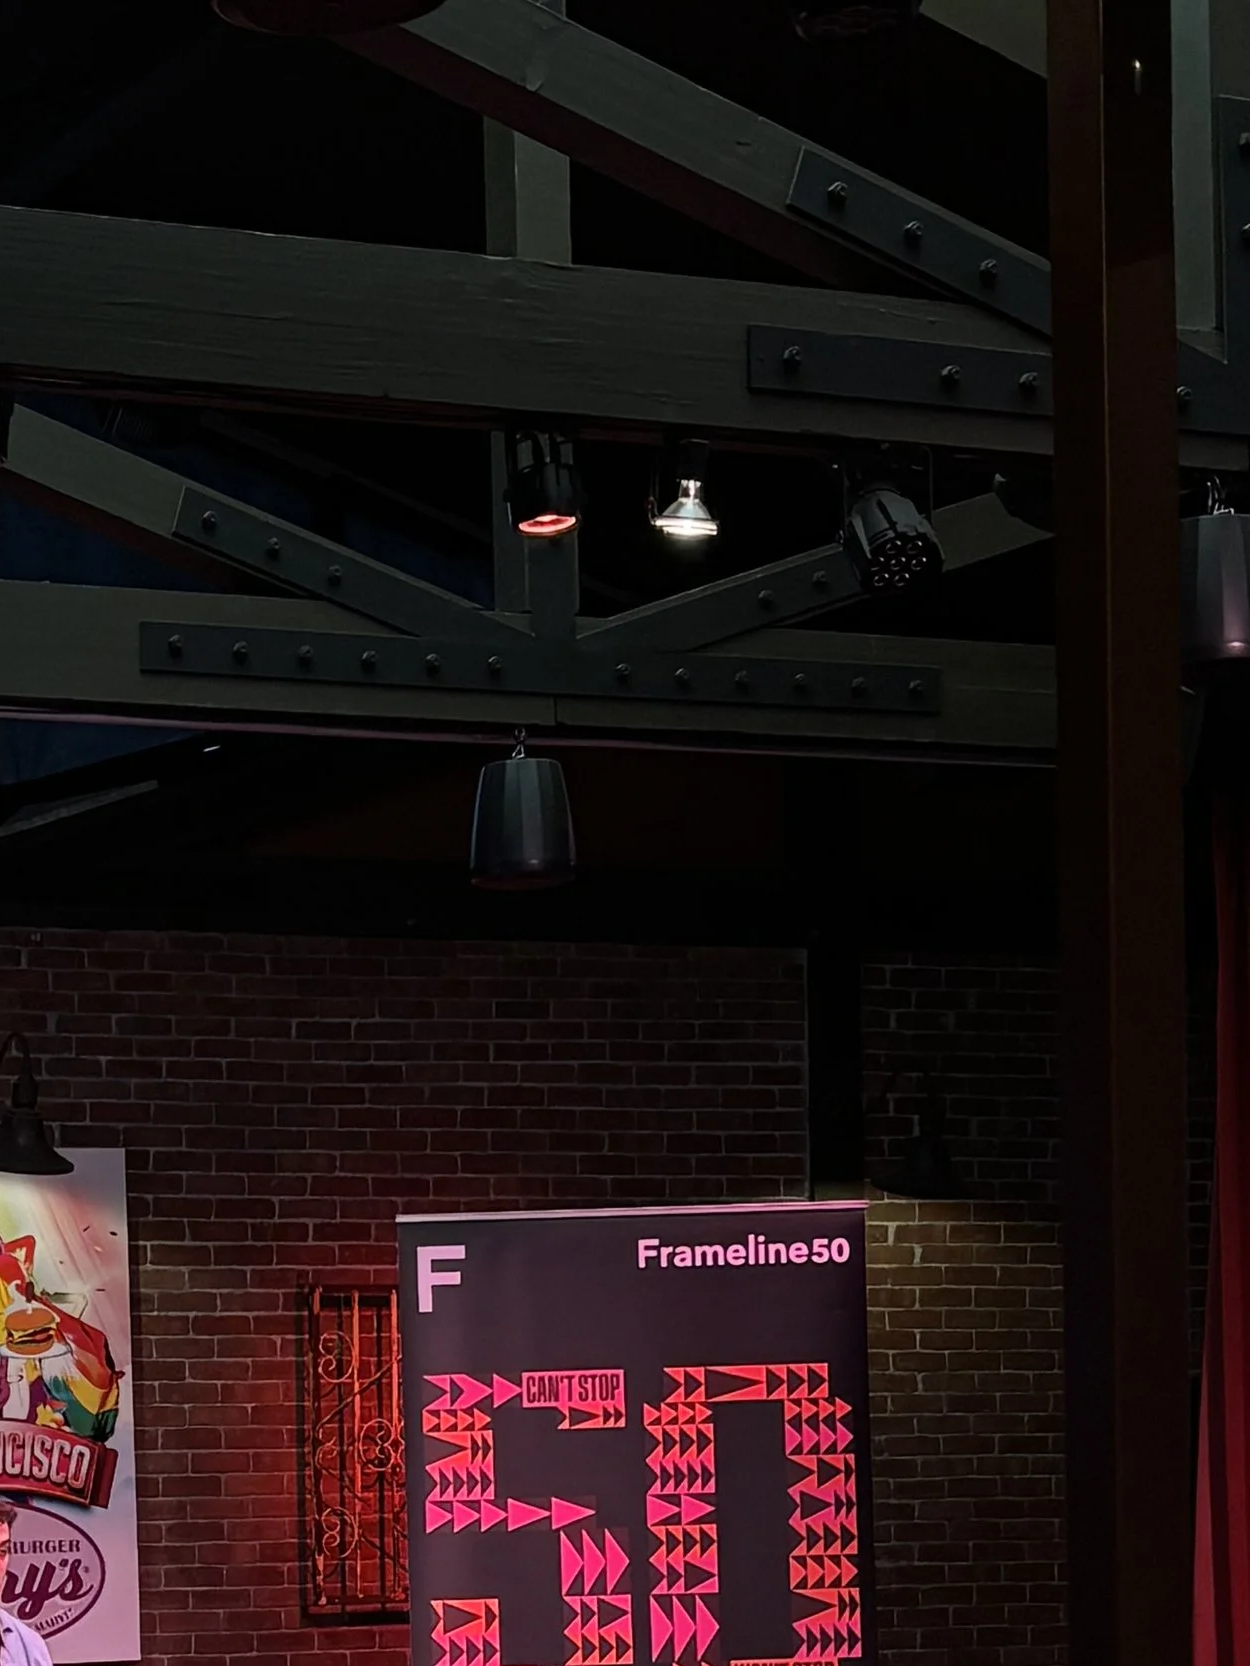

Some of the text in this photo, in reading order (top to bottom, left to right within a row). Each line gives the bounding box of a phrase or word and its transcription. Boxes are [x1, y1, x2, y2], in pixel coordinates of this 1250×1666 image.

[637, 1235, 851, 1269] Frameline50
[526, 1373, 620, 1403] CAN'T STOP
